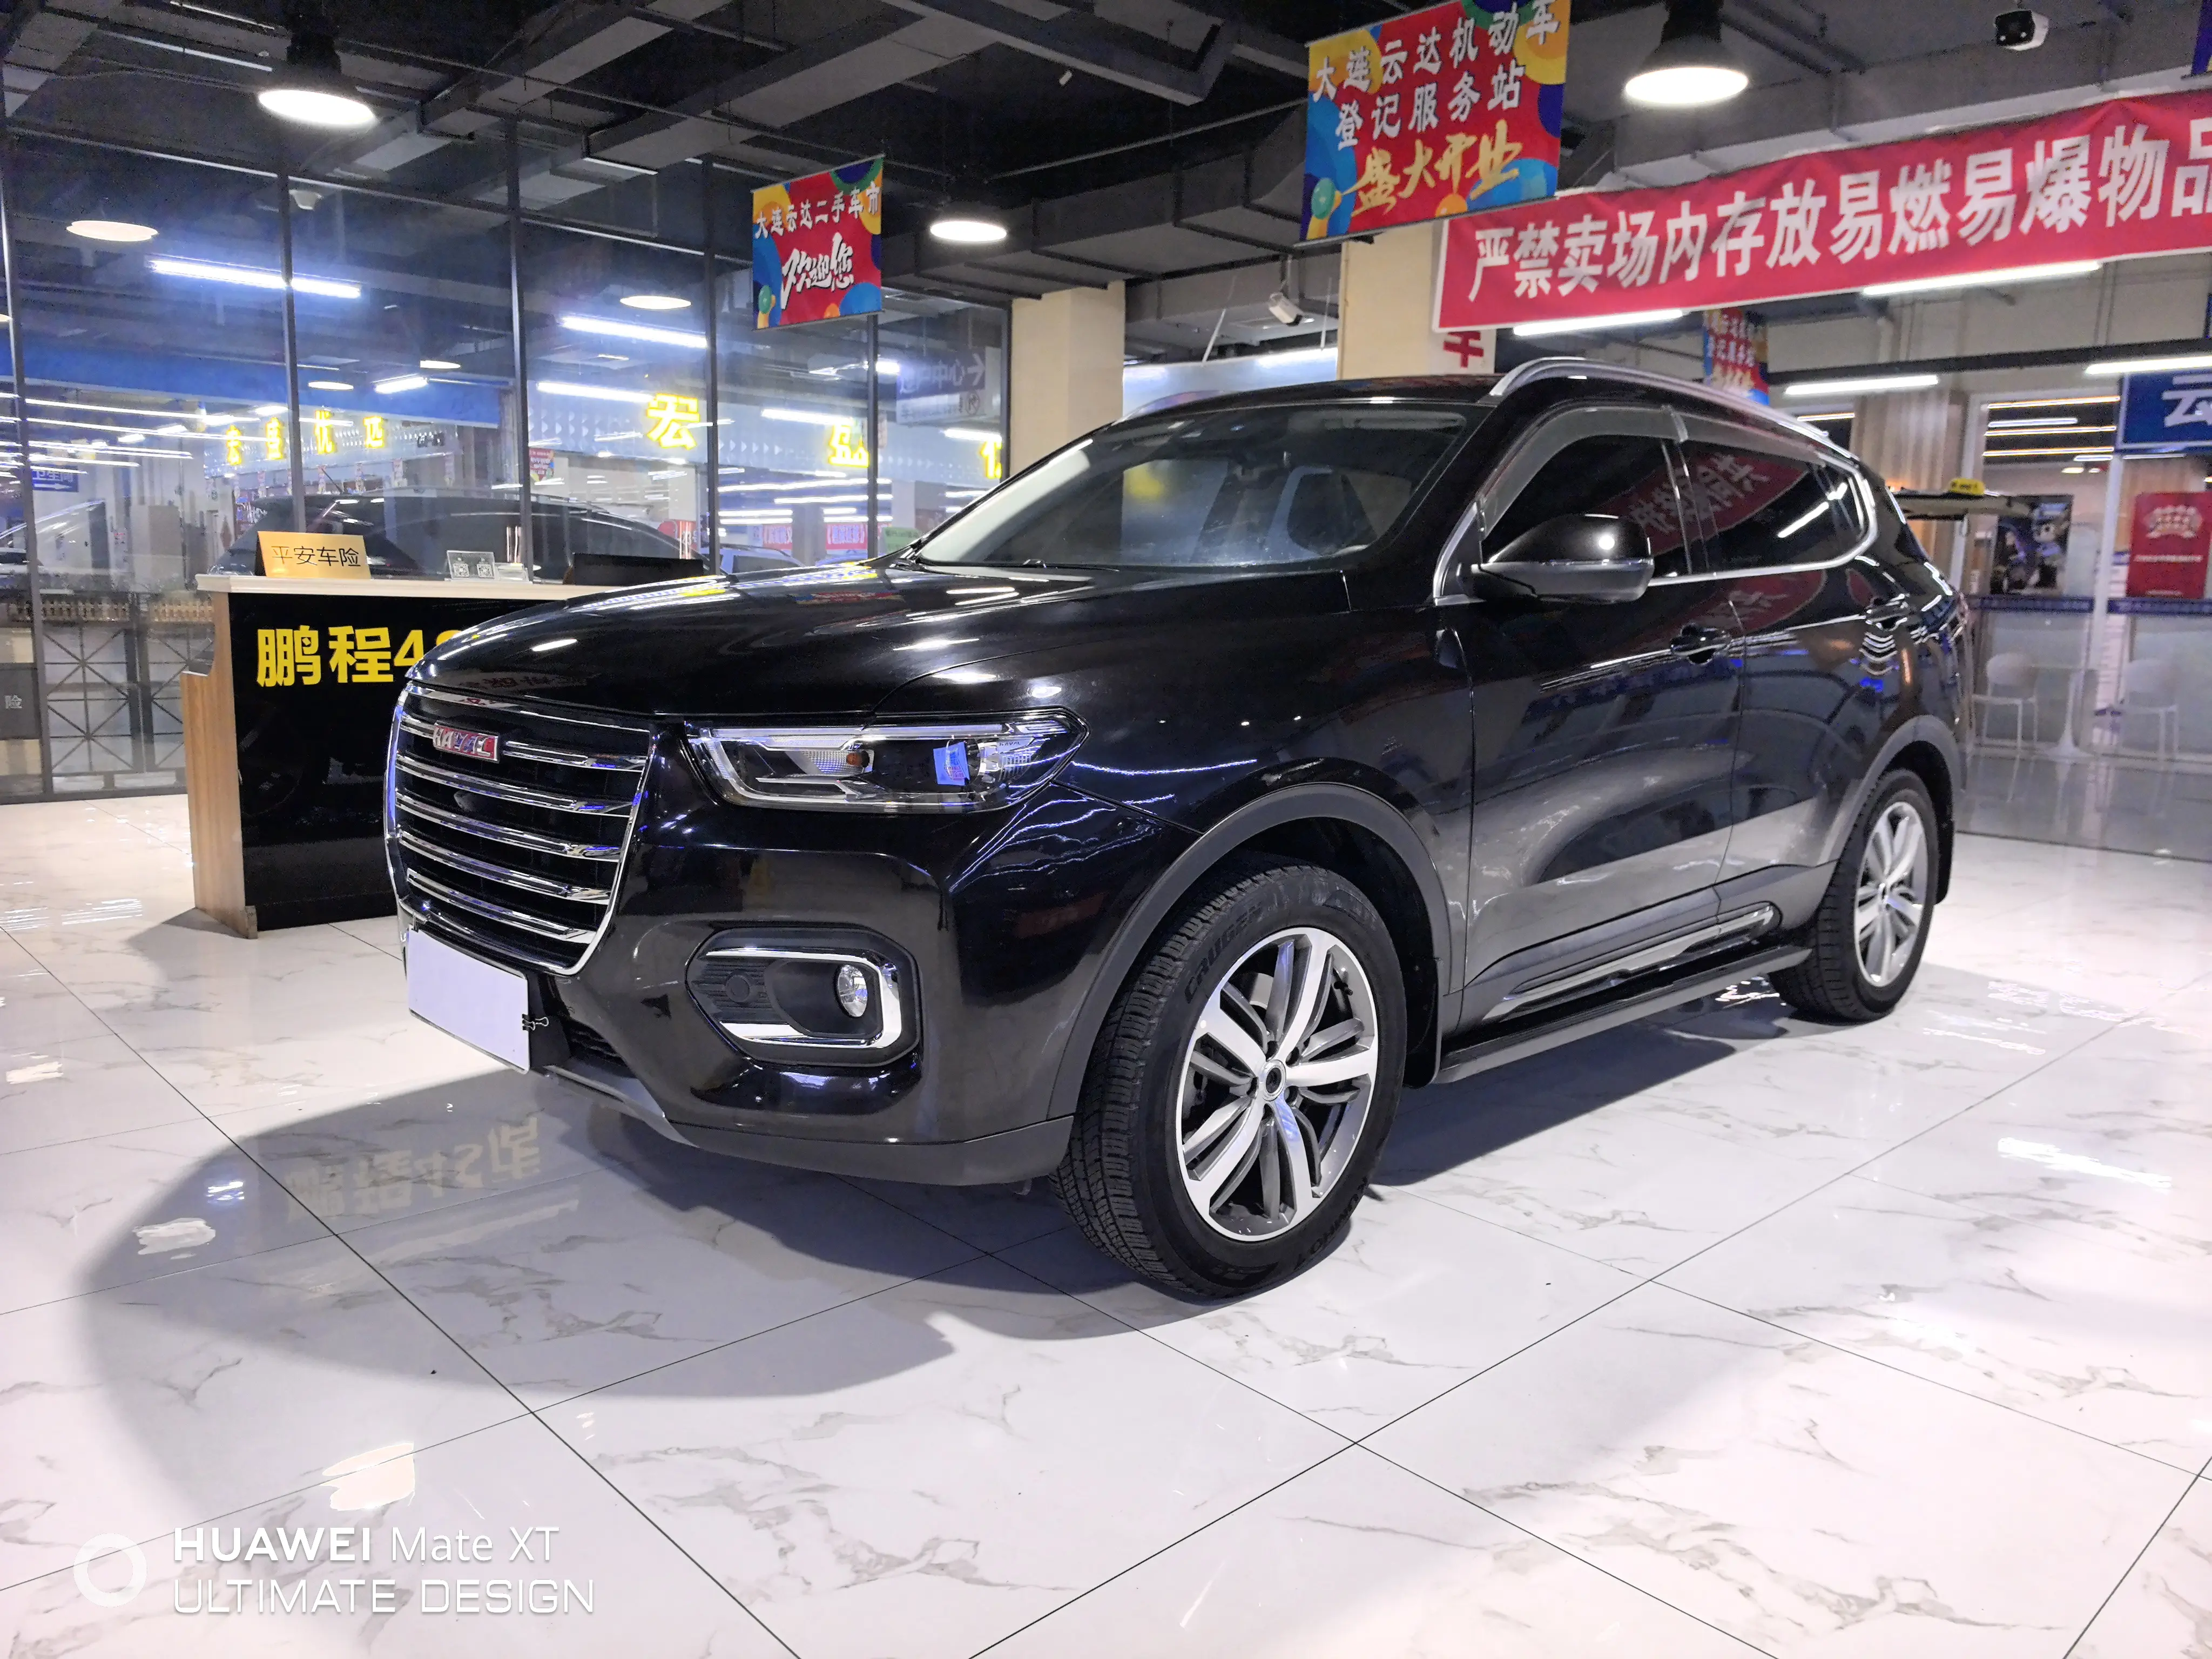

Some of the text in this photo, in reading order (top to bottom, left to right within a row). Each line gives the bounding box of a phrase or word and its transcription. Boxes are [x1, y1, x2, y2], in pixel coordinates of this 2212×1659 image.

[1336, 59, 1526, 151] 登记服务站
[1342, 118, 1524, 217] 盛大开业
[1468, 117, 2212, 302] 严禁卖场内存放易燃易爆物品
[780, 232, 855, 311] 欢迎您
[2161, 374, 2212, 427] 云
[271, 545, 361, 568] 平安车险
[257, 625, 463, 687] 鹏程4
[433, 726, 491, 757] HAVAL
